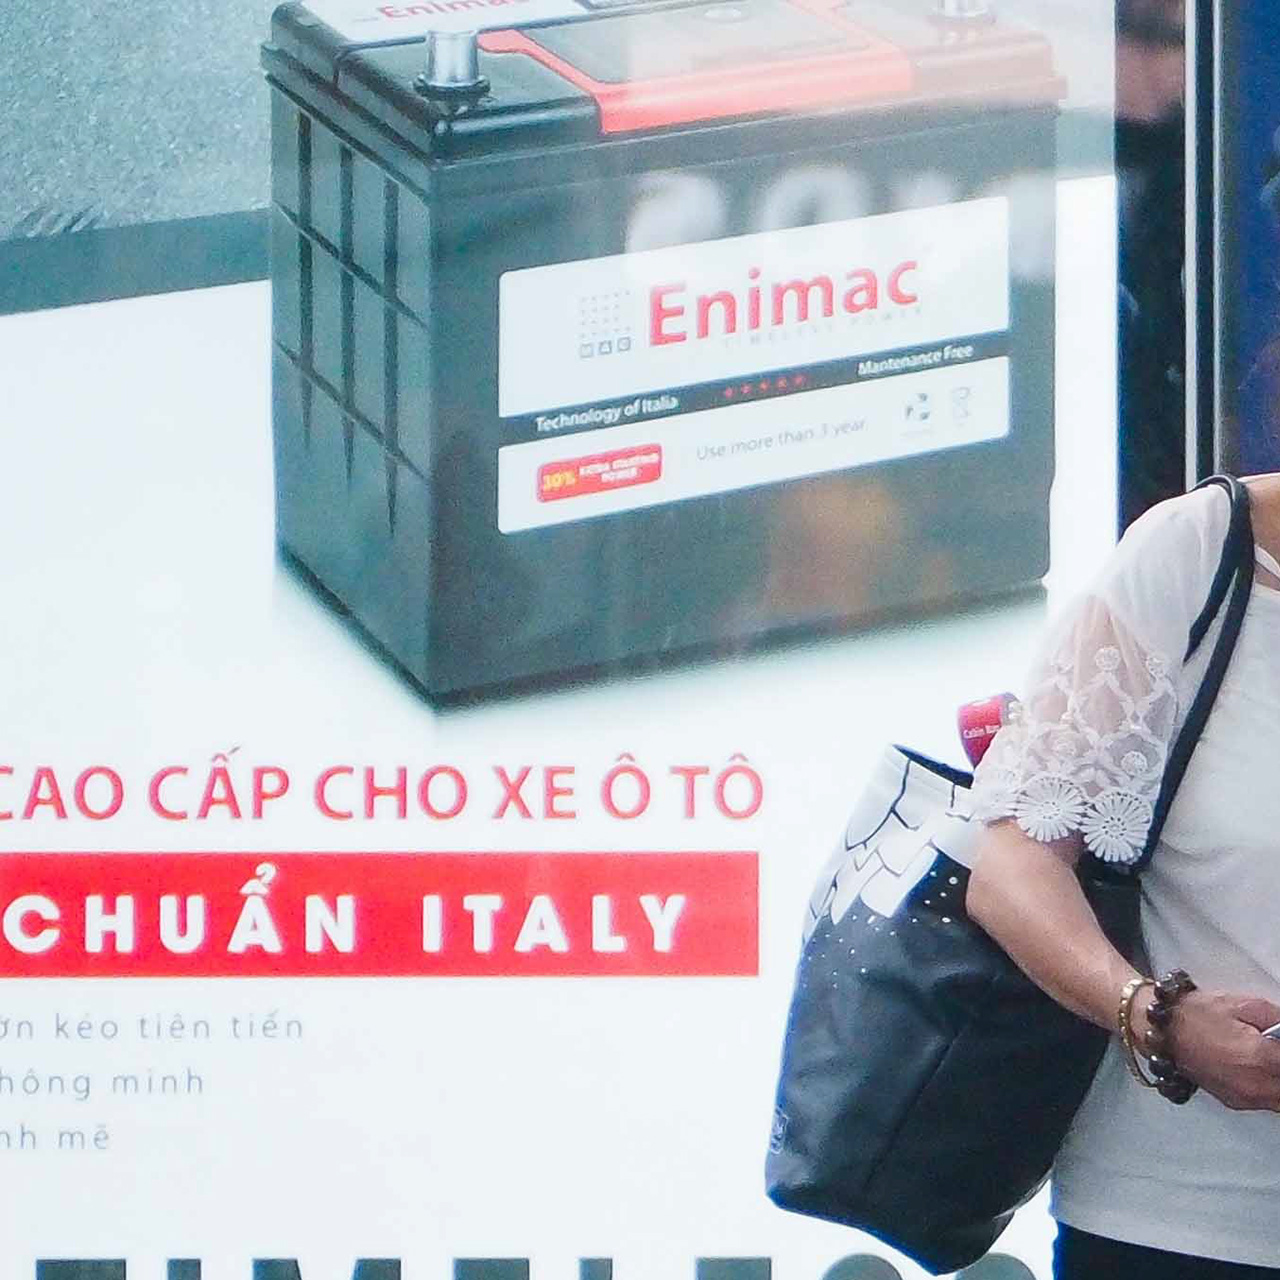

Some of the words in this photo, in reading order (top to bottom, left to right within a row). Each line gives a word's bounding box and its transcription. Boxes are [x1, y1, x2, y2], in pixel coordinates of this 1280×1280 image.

[378, 0, 531, 20] Enima
[648, 260, 920, 346] Enimac
[535, 407, 621, 432] Technology
[624, 399, 640, 416] of
[696, 444, 726, 460] Use
[731, 434, 774, 454] more
[778, 428, 814, 445] than
[148, 745, 290, 821] CẤP
[314, 764, 468, 821] CHO
[492, 765, 577, 820] XE
[600, 751, 651, 821] Ô
[668, 751, 764, 821] TÔ
[2, 862, 356, 954] CHUẨN
[421, 893, 686, 954] ITALY
[139, 1012, 211, 1040] tiên
[231, 1008, 304, 1040] tiến
[112, 1067, 204, 1095] minh
